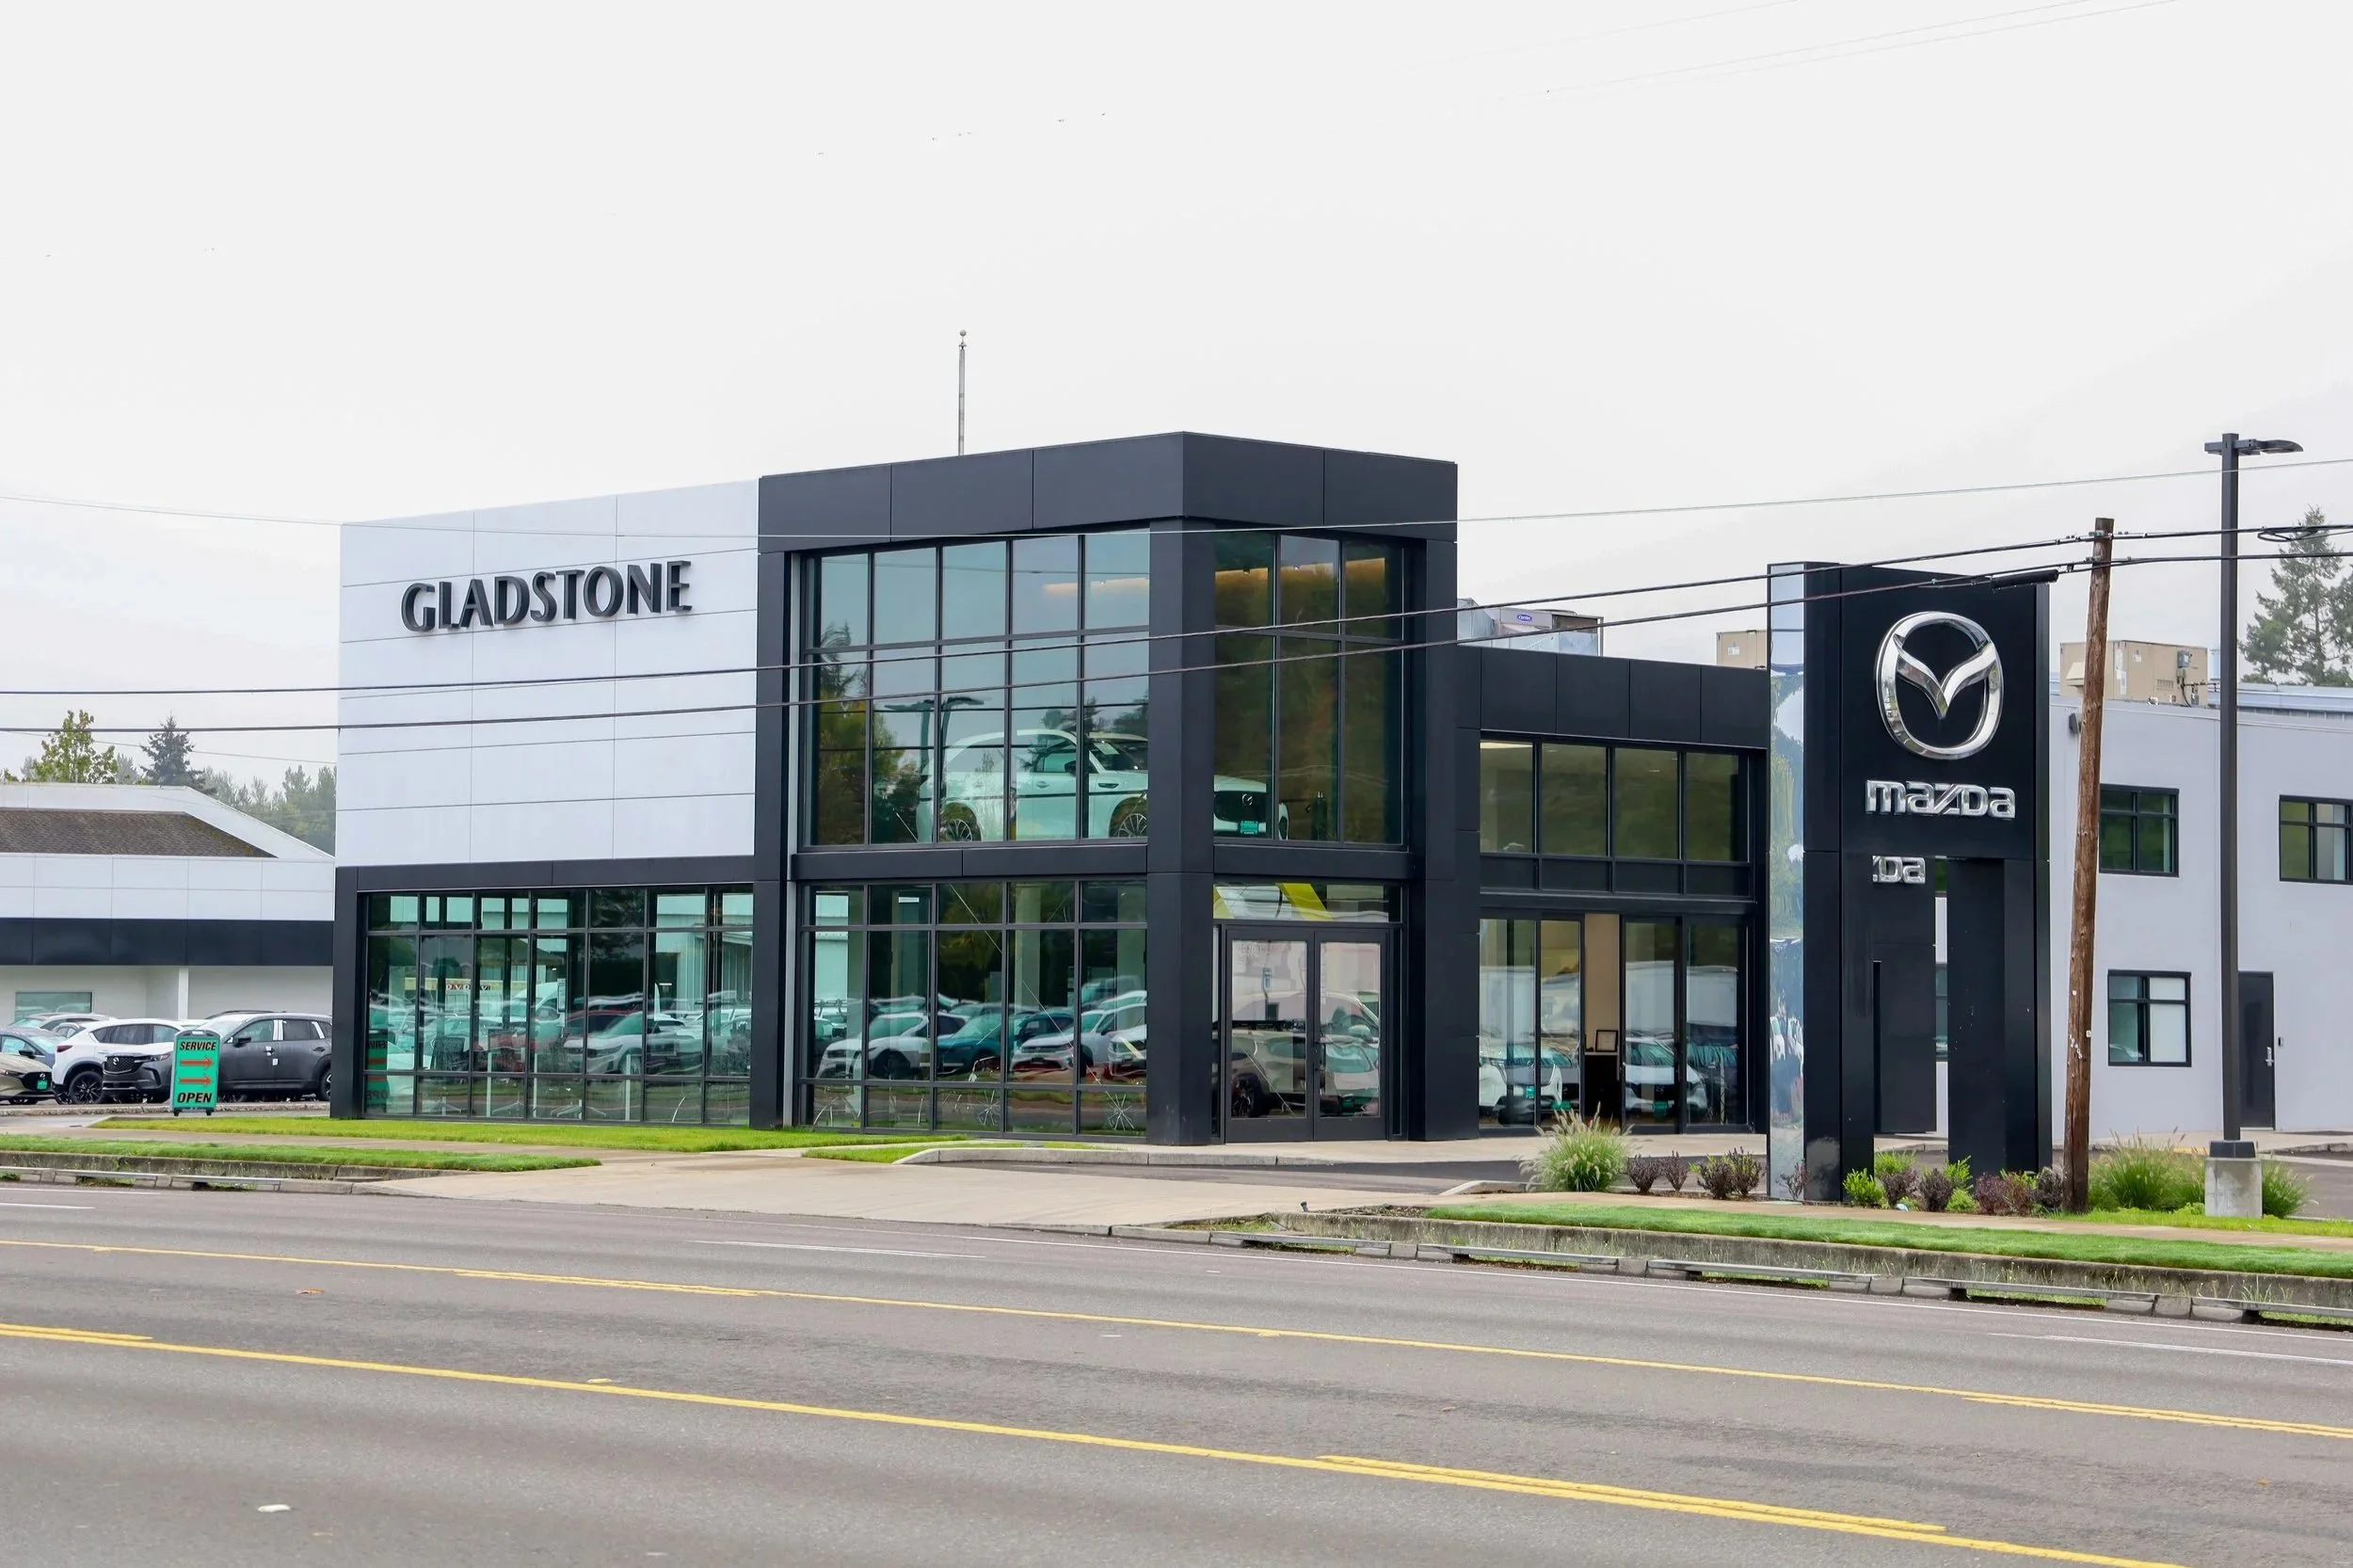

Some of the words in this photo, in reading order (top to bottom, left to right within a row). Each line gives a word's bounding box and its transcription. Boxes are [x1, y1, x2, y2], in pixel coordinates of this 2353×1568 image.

[401, 560, 692, 632] GLADSTONE
[180, 1041, 216, 1051] SERVICE
[177, 1092, 213, 1103] OPEN
